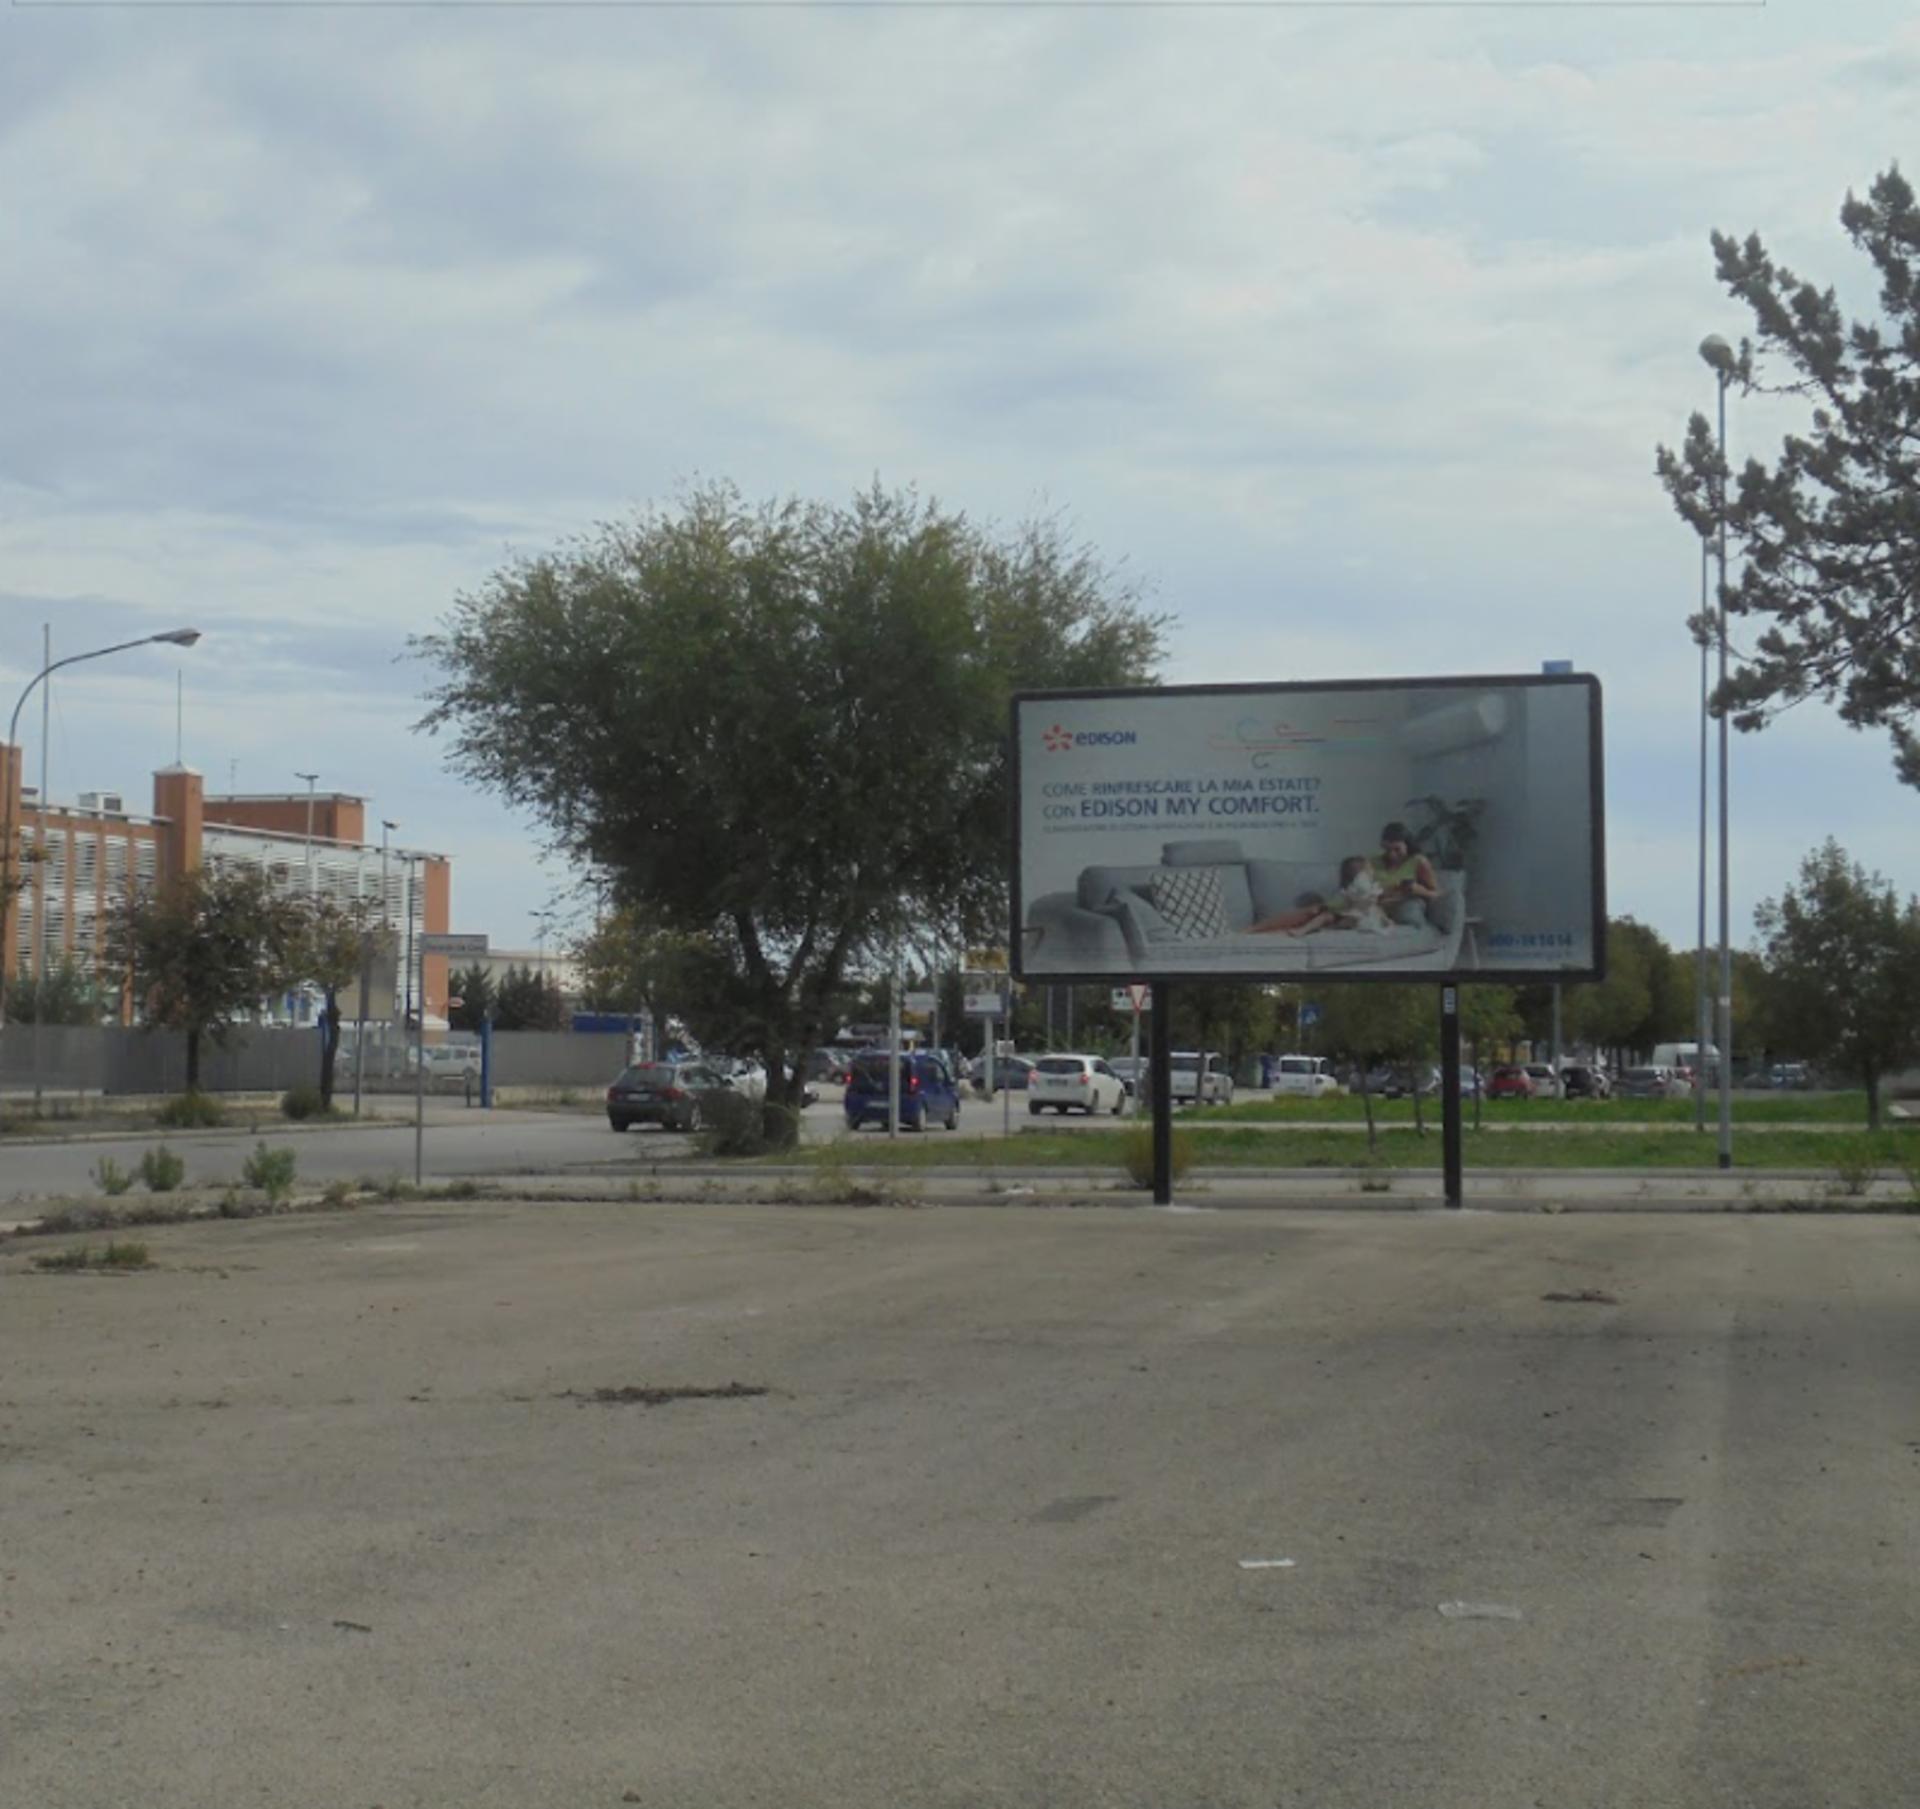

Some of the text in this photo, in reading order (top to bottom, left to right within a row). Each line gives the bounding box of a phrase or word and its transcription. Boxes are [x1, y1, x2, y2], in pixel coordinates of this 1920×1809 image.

[1042, 782, 1088, 798] COME
[1199, 779, 1218, 793] LA
[1223, 778, 1254, 792] MIA
[1042, 795, 1320, 819] CON EDISON MY COMFORT.
